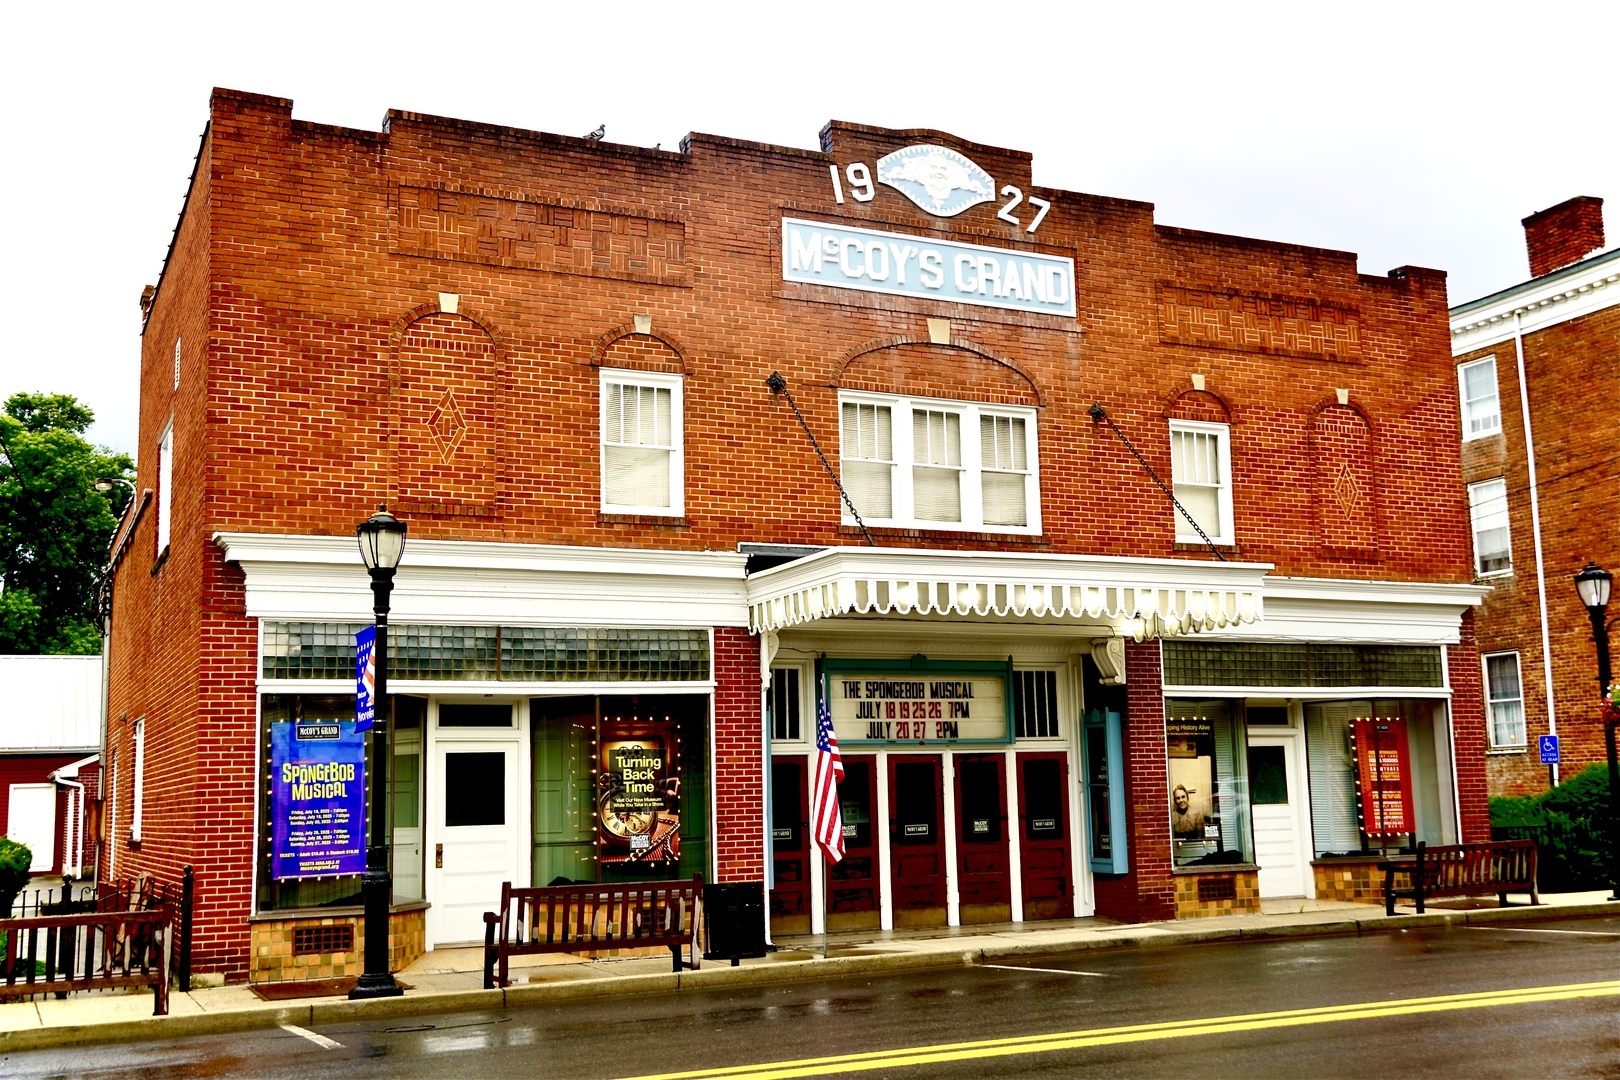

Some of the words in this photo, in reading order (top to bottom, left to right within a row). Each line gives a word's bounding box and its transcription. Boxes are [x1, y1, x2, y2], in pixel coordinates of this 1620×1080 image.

[830, 162, 876, 204] 19
[997, 184, 1050, 233] 27
[790, 228, 944, 289] McCOY'S
[954, 254, 1068, 305] GRAND
[842, 681, 861, 698] THE
[866, 682, 924, 699] SPONGEBOB
[930, 682, 974, 699] MUSICAL
[856, 702, 881, 719] JULY
[886, 702, 895, 719] 18
[899, 702, 910, 719] 19
[913, 702, 926, 719] 25
[928, 702, 941, 719] 26
[948, 702, 970, 719] 7PM
[866, 722, 891, 739] JULY
[896, 722, 909, 739] 20
[914, 722, 926, 739] 27
[936, 722, 958, 739] 2PM
[616, 756, 661, 769] Turning
[282, 762, 355, 784] SPONGEBOB
[623, 769, 654, 780] Back
[292, 782, 348, 800] MUSICAL
[623, 781, 654, 792] Time
